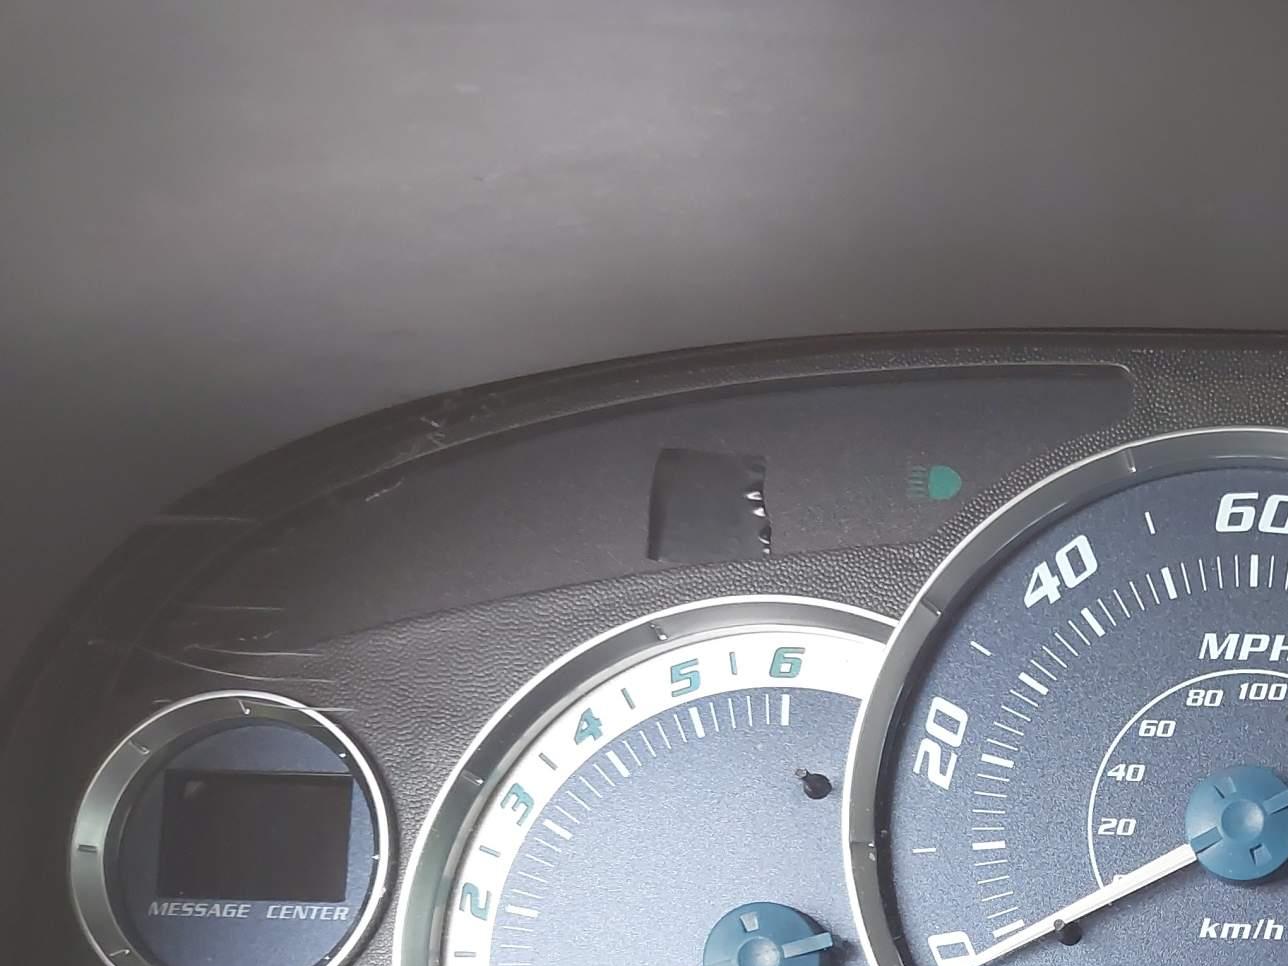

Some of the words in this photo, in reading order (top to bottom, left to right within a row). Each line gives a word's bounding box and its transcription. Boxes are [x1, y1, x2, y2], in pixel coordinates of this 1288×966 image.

[1022, 534, 1098, 609] 40
[768, 647, 806, 679] 6
[670, 659, 700, 698] 5
[1238, 683, 1287, 701] 100
[1186, 689, 1223, 707] 80
[573, 707, 603, 745] 4
[1138, 719, 1176, 738] 60
[914, 696, 969, 790] 20
[1107, 764, 1146, 782] 40
[500, 782, 535, 826] 3
[1098, 817, 1136, 836] 20
[148, 901, 251, 919] MESSAGE
[266, 904, 350, 921] CENTER
[458, 881, 492, 921] 2
[1199, 918, 1285, 942] km/h
